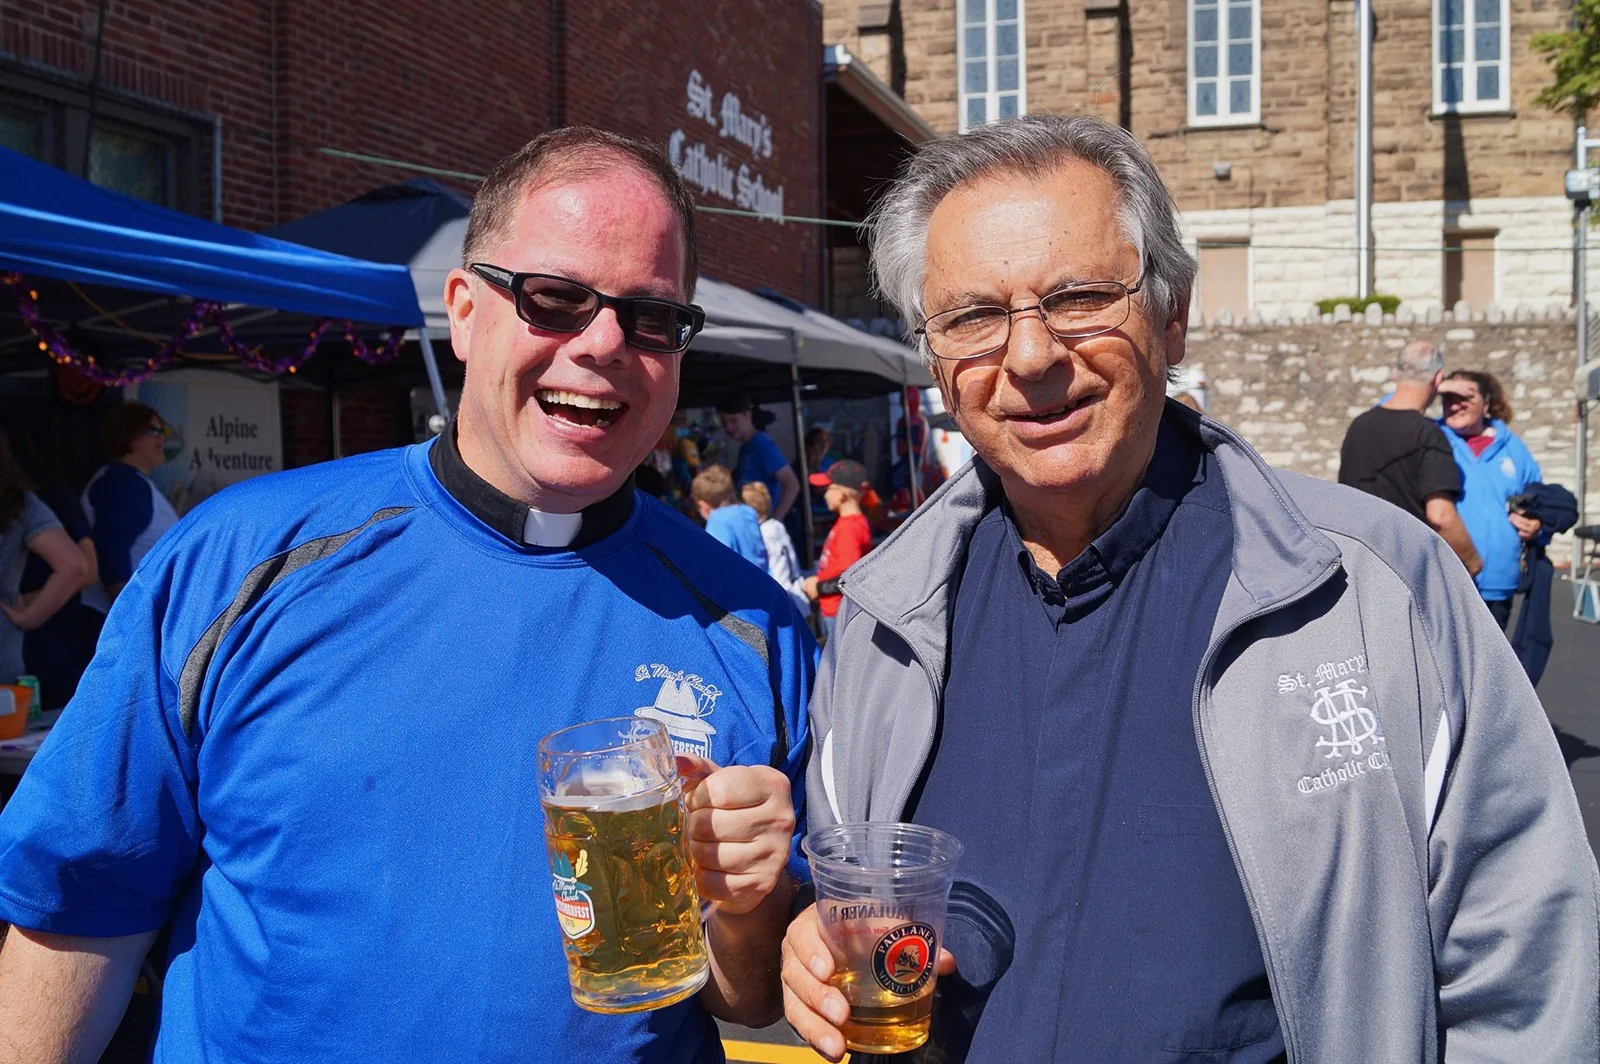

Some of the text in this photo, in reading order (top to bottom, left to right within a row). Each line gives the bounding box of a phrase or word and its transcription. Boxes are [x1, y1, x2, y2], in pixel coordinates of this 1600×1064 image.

[719, 92, 773, 161] Mary's
[669, 129, 784, 225] Catholic School
[205, 414, 258, 444] Alpine
[1297, 758, 1366, 794] Catholic
[878, 926, 935, 954] PAULANER
